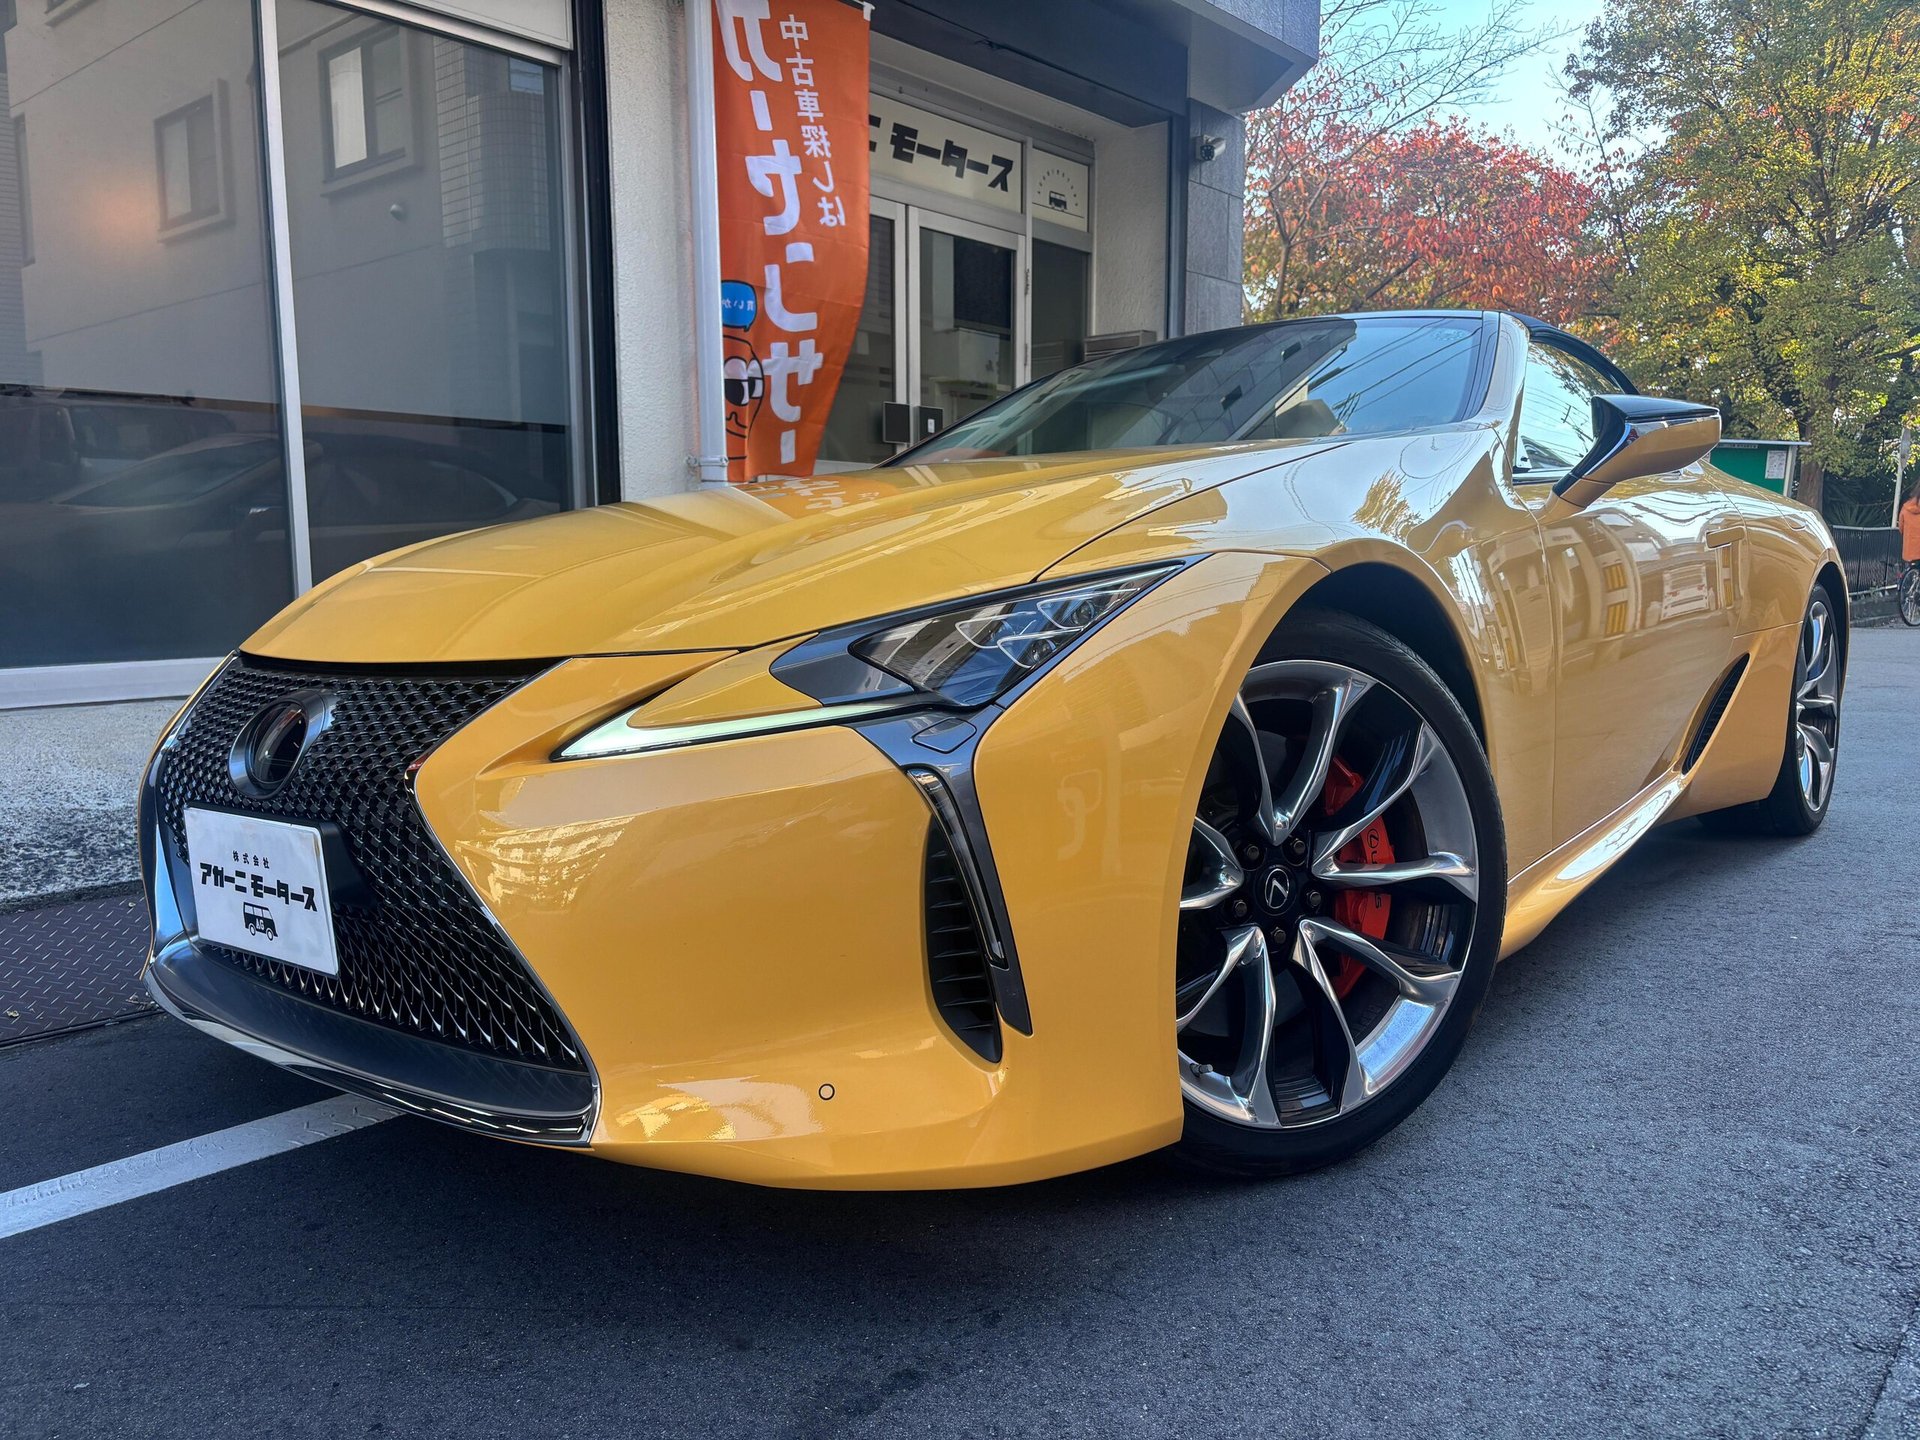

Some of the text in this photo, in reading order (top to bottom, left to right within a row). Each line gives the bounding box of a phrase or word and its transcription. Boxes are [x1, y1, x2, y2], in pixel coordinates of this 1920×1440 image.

[890, 122, 1014, 192] モータース
[232, 850, 270, 869] 株式会社
[251, 873, 318, 912] モータース
